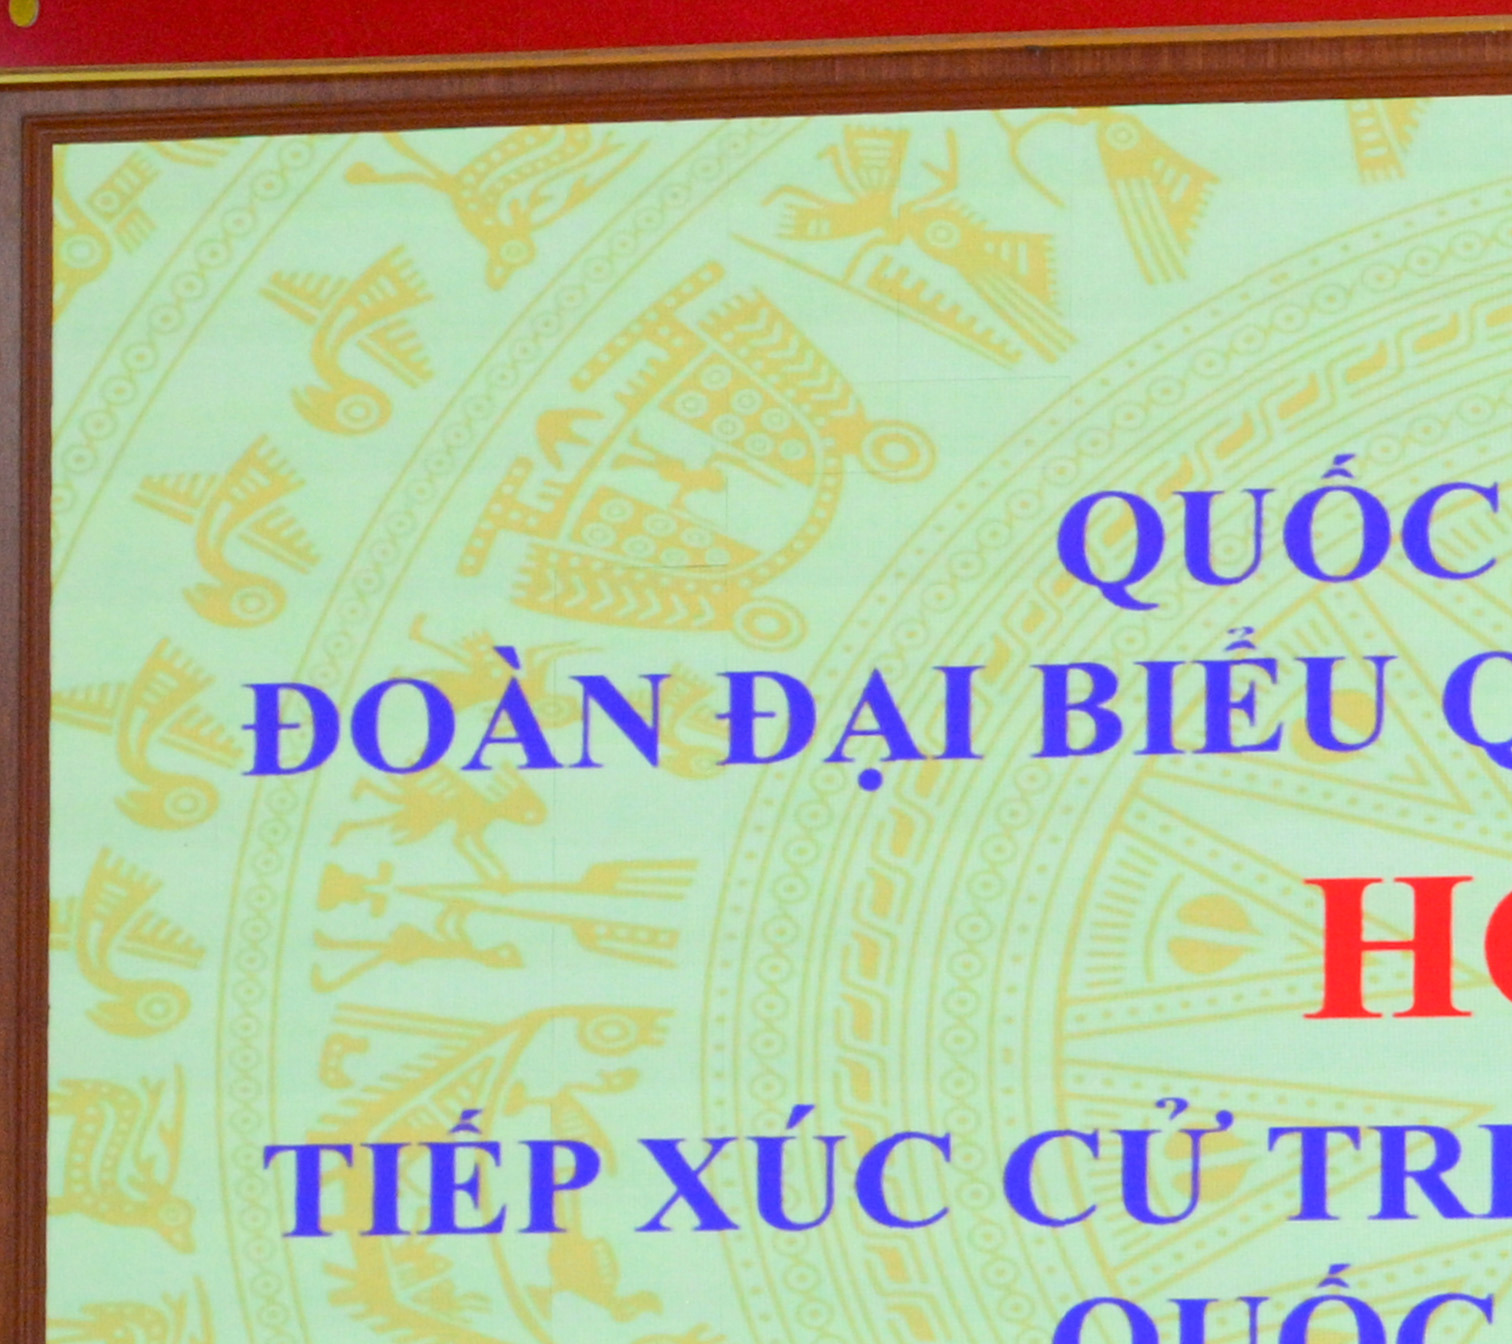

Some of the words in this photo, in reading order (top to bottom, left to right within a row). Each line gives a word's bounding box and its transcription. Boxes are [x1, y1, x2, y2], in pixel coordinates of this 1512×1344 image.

[1056, 452, 1503, 612] QUỐC
[242, 644, 670, 777] ĐOÀN
[716, 664, 983, 793] ĐẠI
[1033, 625, 1397, 760] BIỂU
[263, 1108, 603, 1239] TIẾP
[636, 1103, 953, 1234] XÚC
[1003, 1096, 1235, 1229] CỬ
